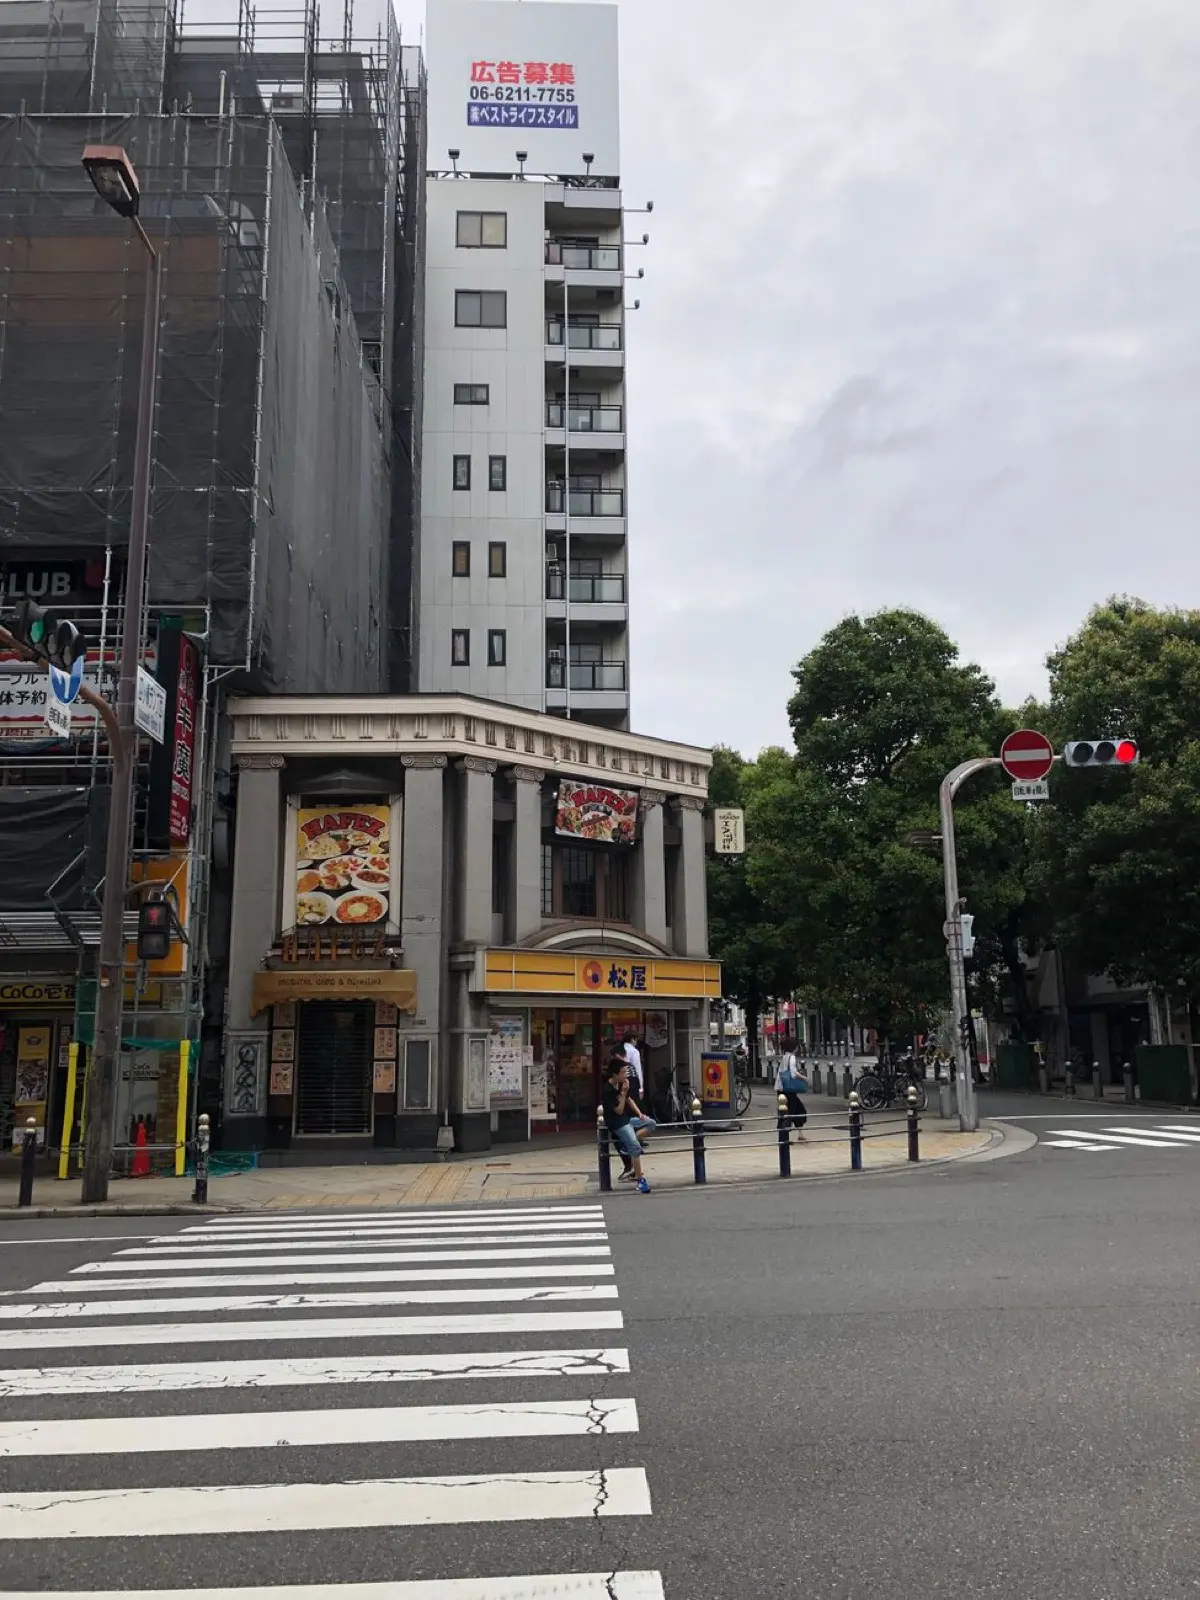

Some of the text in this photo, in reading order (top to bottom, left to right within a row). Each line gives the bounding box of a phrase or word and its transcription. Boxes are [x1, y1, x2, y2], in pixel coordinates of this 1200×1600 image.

[469, 60, 576, 85] 広告募集
[470, 86, 575, 103] 06-6211-7755
[301, 812, 386, 840] HAFEZ
[608, 964, 647, 991] 松屋
